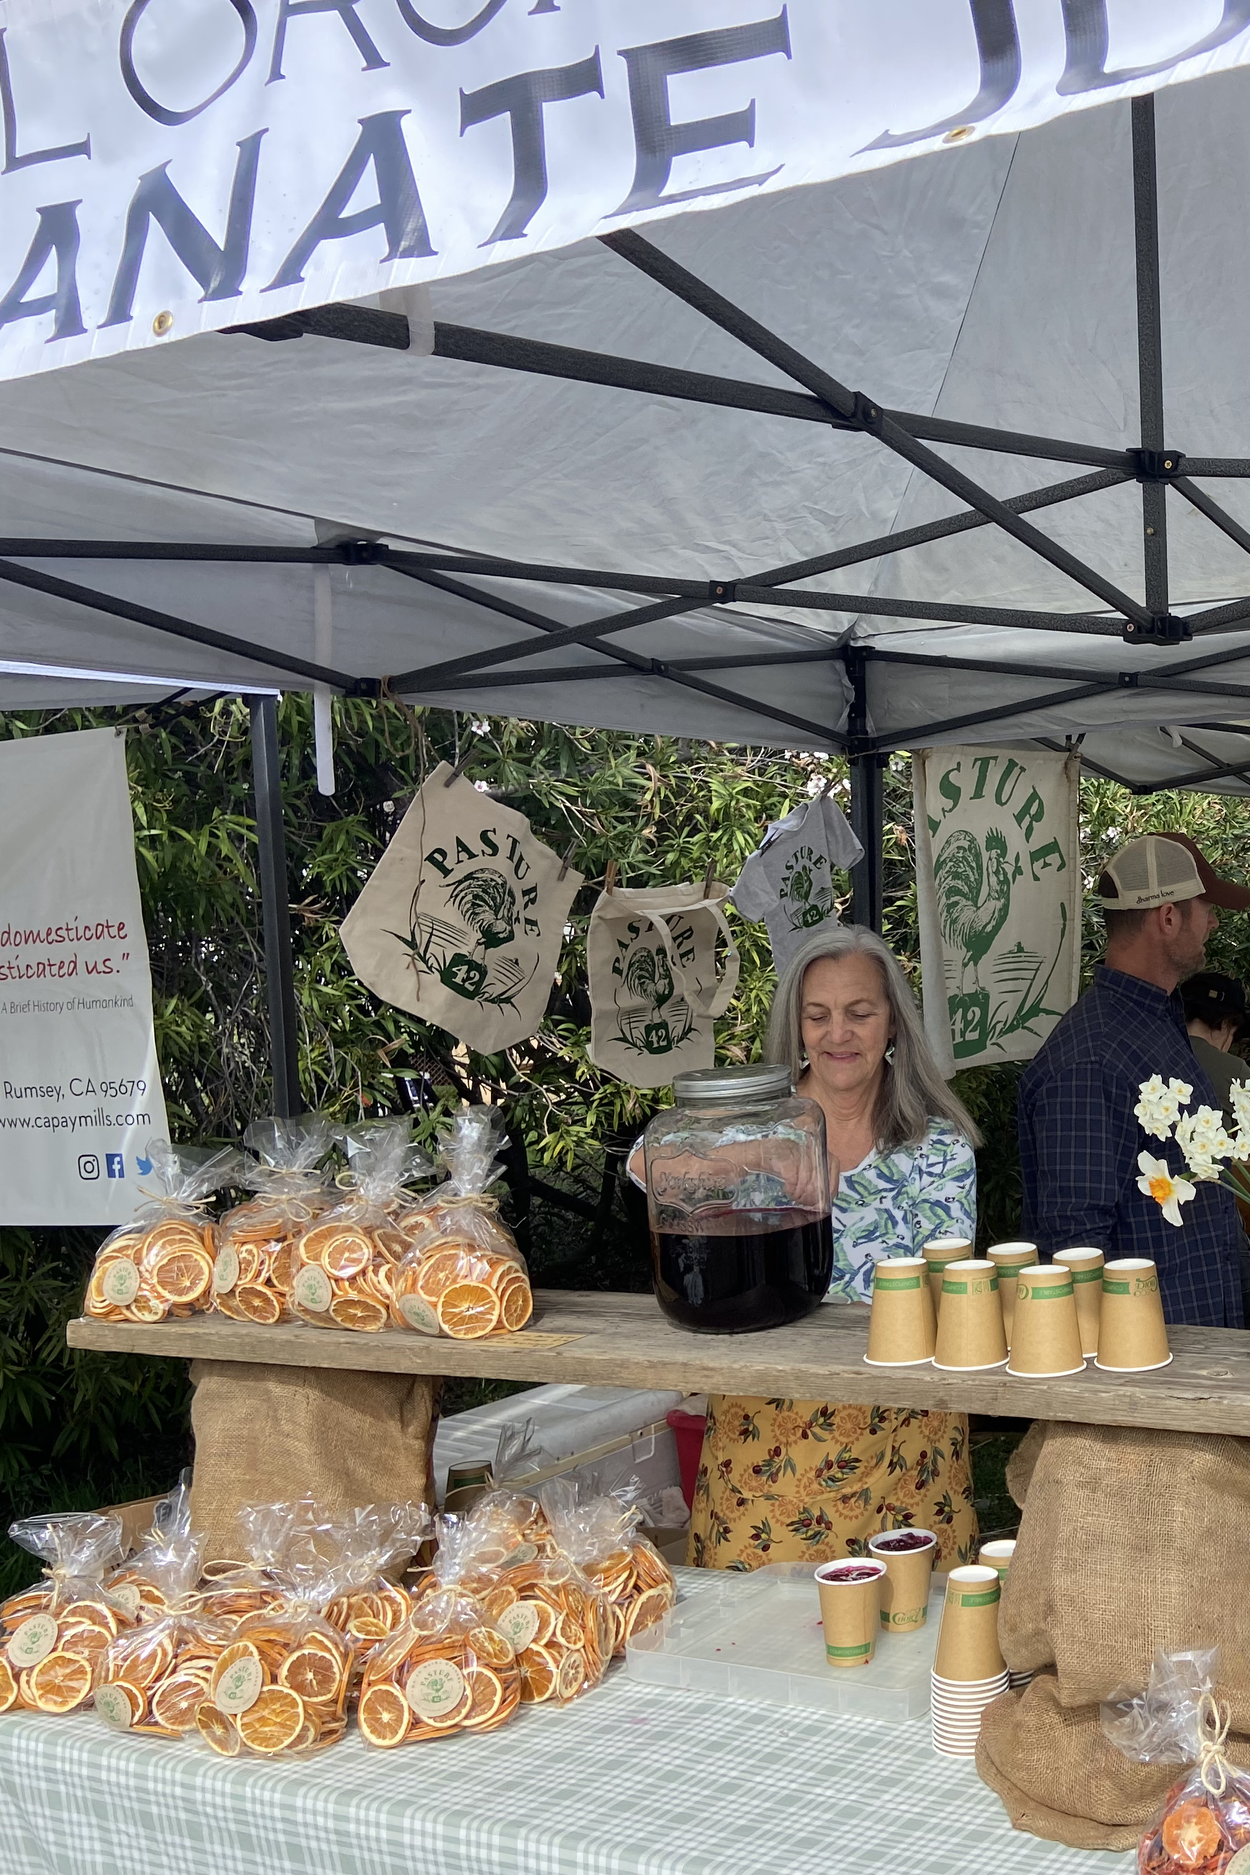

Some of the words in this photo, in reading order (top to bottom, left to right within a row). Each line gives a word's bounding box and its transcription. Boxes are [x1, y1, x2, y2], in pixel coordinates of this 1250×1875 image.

[928, 756, 1067, 882] STURE
[424, 827, 541, 939] PASTURE
[780, 845, 827, 900] PASTURE
[1136, 894, 1160, 905] dharma
[1160, 890, 1175, 898] love
[0, 916, 128, 947] domesticate
[451, 964, 482, 993] 42
[1, 1002, 8, 1014] A
[10, 1000, 31, 1014] Brief
[33, 999, 64, 1014] History
[66, 997, 76, 1011] of
[77, 994, 134, 1010] Humankind
[649, 1028, 668, 1048] 42
[951, 1006, 982, 1045] 42
[4, 1081, 65, 1103] Rumsey,
[69, 1078, 97, 1097] CA
[100, 1078, 147, 1098] 95679
[420, 1669, 454, 1687] PASTURE
